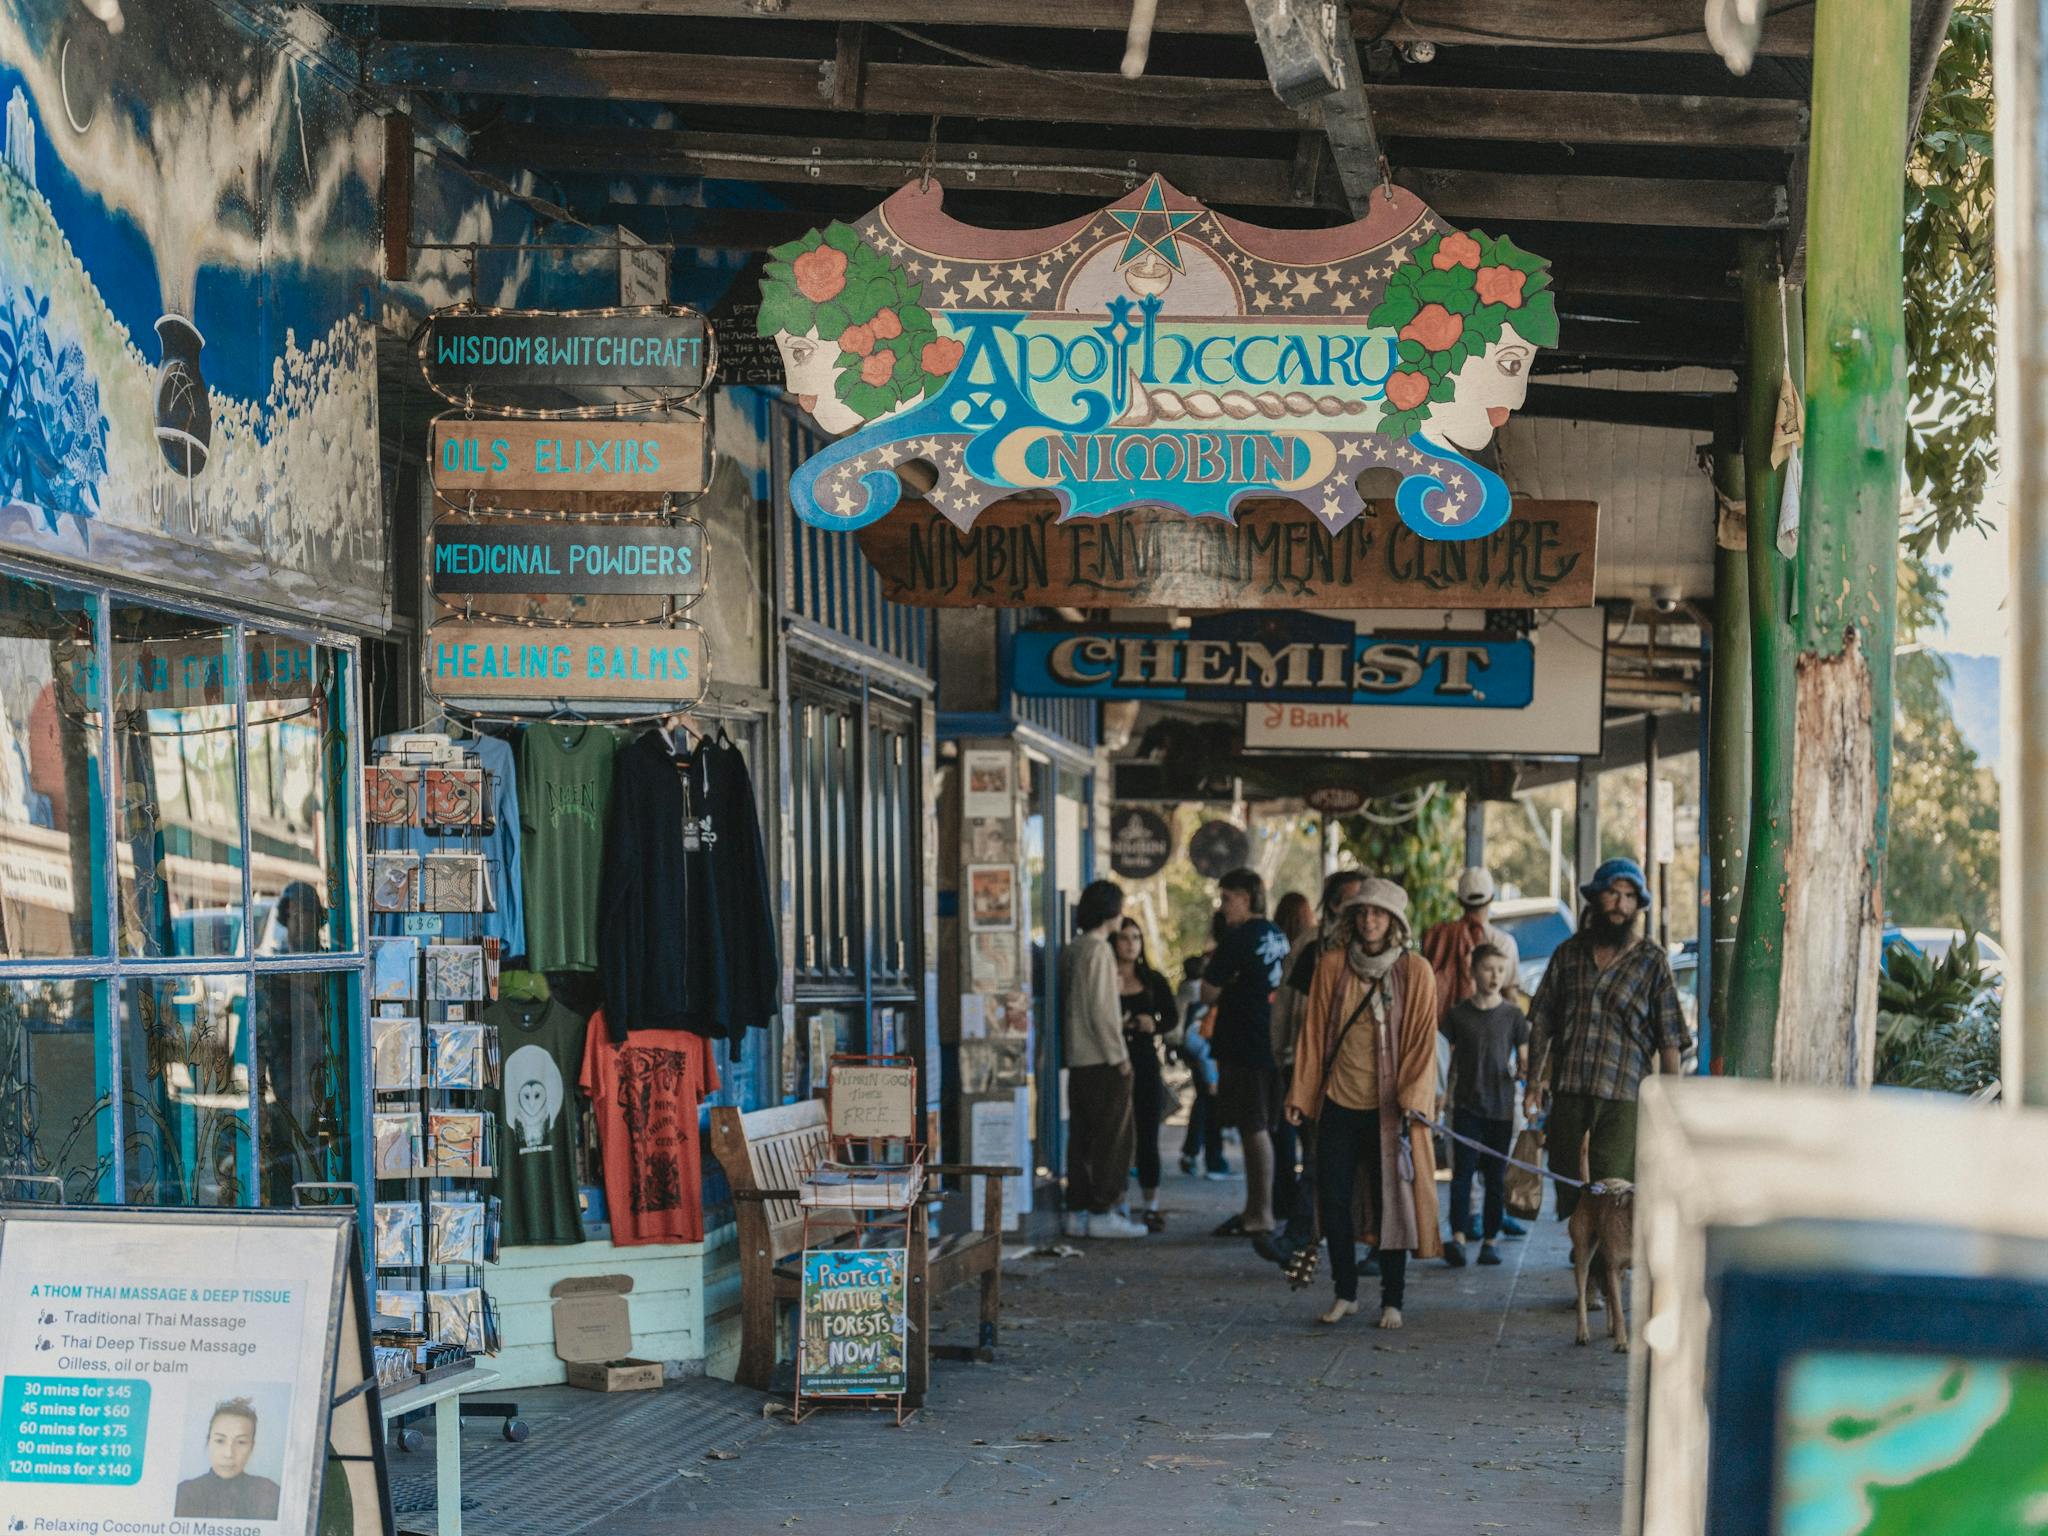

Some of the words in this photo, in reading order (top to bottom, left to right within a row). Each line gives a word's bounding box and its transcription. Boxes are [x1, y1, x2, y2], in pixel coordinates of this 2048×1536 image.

[438, 335, 702, 368] WISDOM&WITCHCRAFT
[443, 438, 510, 473] OILS
[535, 438, 661, 474] ELIXIRS
[1045, 433, 1301, 483] NIMBIN
[436, 543, 561, 576] MEDICINAL
[569, 544, 693, 576] POWDERS
[893, 512, 1055, 600] NIMBIN
[437, 643, 571, 679] HEALING
[588, 644, 690, 682] BALMS
[1047, 636, 1491, 695] CHEMIST
[1290, 708, 1349, 729] Bank
[31, 1286, 40, 1297] A
[44, 1285, 82, 1298] THOM
[86, 1286, 117, 1299] THAI
[120, 1287, 187, 1301] MASSAGE
[190, 1289, 199, 1301] &
[203, 1290, 239, 1302] DEEP
[242, 1290, 291, 1303] TISSUE
[64, 1310, 141, 1325] Traditional
[145, 1312, 177, 1326] Thai
[180, 1313, 246, 1331] Massage
[61, 1335, 92, 1349] Thai
[96, 1336, 135, 1352] Deep
[138, 1337, 186, 1351] Tissue
[190, 1339, 257, 1356] Massage
[58, 1356, 111, 1372] Oilless,
[114, 1357, 132, 1372] oil
[135, 1361, 150, 1372] or
[153, 1358, 189, 1373] balm
[24, 1382, 41, 1396] 30
[44, 1384, 79, 1397] mins
[82, 1384, 103, 1397] for
[106, 1385, 131, 1399] $45
[21, 1402, 37, 1415] 45
[40, 1403, 76, 1416] mins
[79, 1404, 101, 1417] for
[103, 1404, 130, 1418] $60
[19, 1421, 37, 1434] 60
[39, 1422, 76, 1435] mins
[79, 1423, 100, 1436] for
[103, 1424, 127, 1437] $75
[17, 1441, 34, 1454] 90
[37, 1442, 73, 1455] mins
[76, 1443, 98, 1456] for
[100, 1444, 131, 1458] $110
[9, 1461, 32, 1474] 120
[34, 1462, 71, 1475] mins
[74, 1462, 95, 1475] for
[98, 1463, 131, 1477] $140
[34, 1517, 99, 1534] Relaxing
[103, 1520, 166, 1535] Coconut
[169, 1521, 190, 1535] Oil
[193, 1523, 261, 1536] Massage
